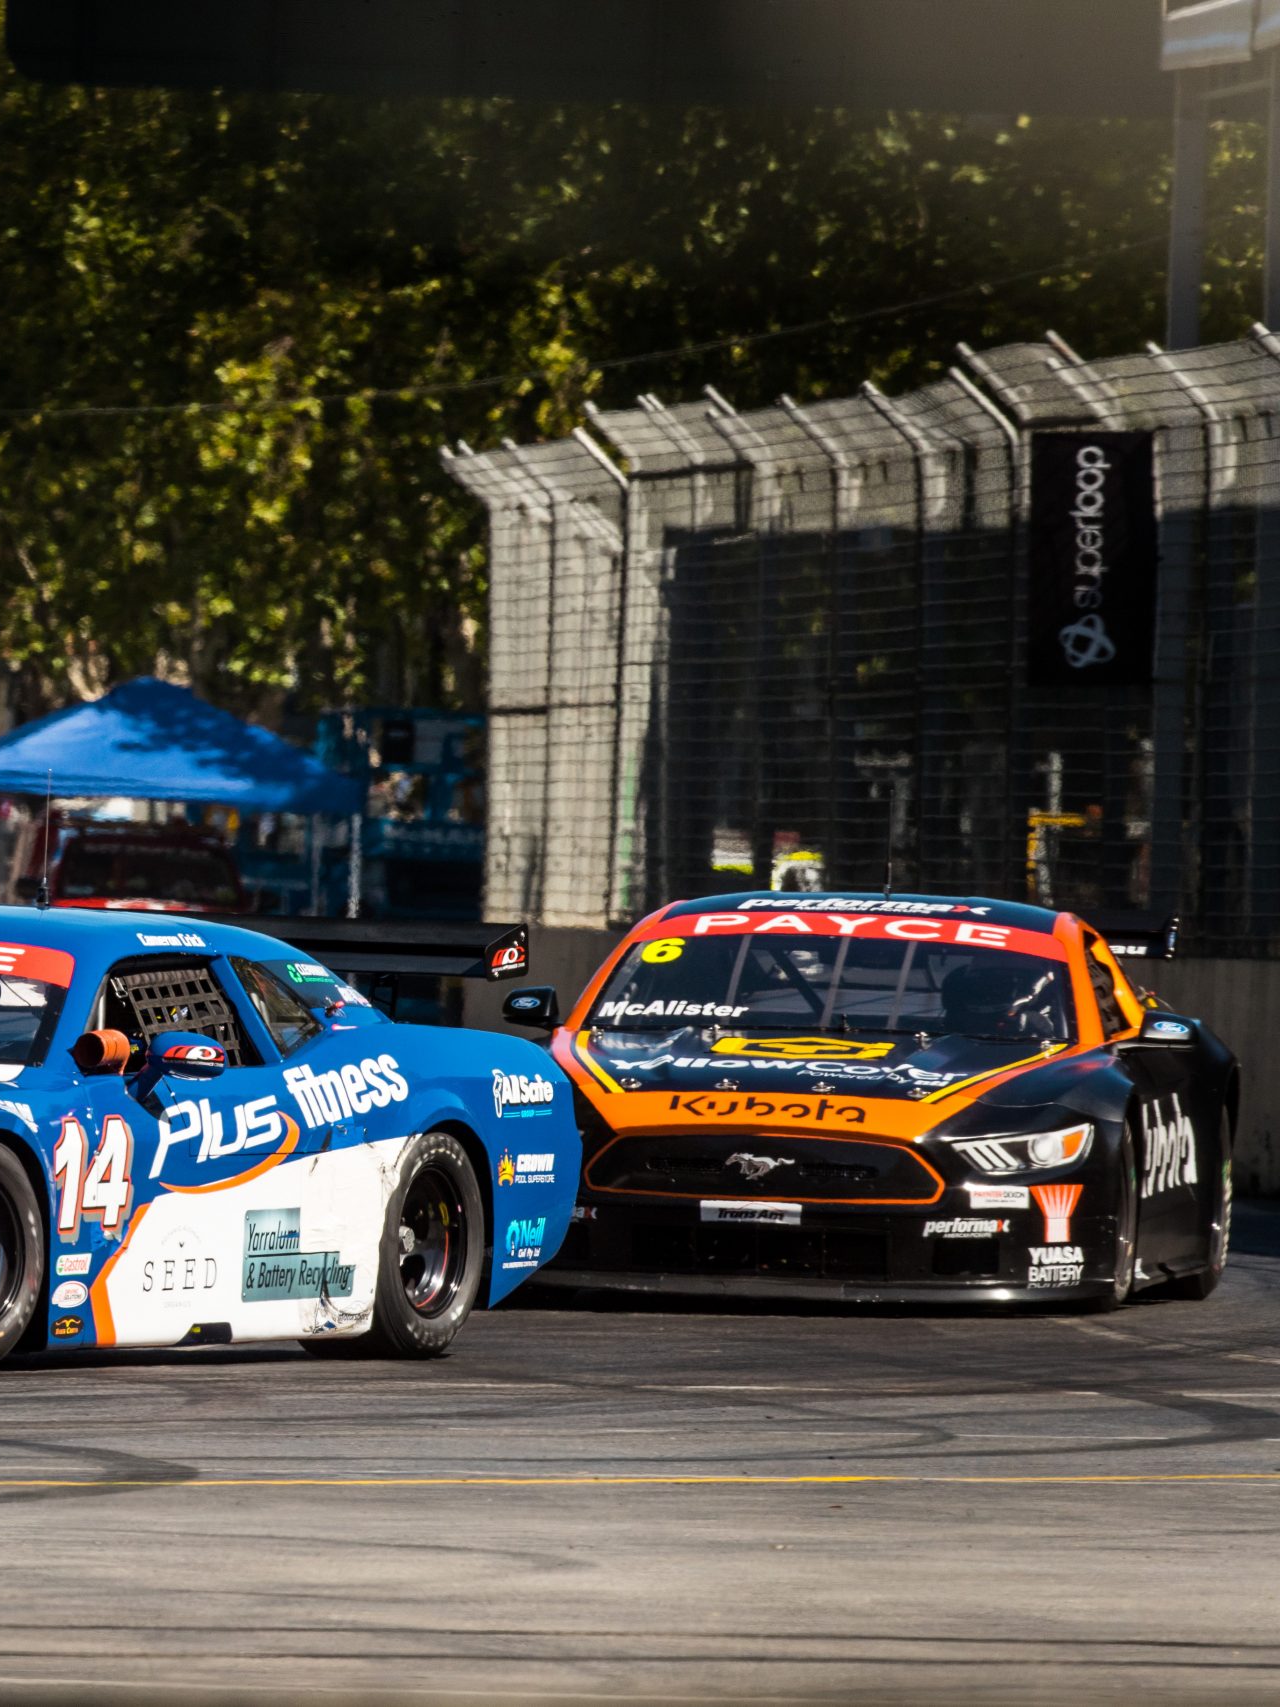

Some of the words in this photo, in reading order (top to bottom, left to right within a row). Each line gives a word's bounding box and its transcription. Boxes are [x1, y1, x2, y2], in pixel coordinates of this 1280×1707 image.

[1069, 446, 1111, 608] superloop
[737, 898, 991, 916] performax
[694, 914, 1011, 947] PAYCE
[641, 937, 686, 964] 6
[598, 1000, 749, 1018] McAlister
[148, 1094, 282, 1179] Plus
[283, 1054, 408, 1128] fitness
[669, 1094, 867, 1124] Kubota
[516, 1153, 554, 1172] CROWN
[53, 1114, 134, 1241] 14
[922, 1217, 1010, 1238] performax
[1028, 1246, 1084, 1265] YUASA
[142, 1258, 218, 1292] SEED
[246, 1262, 255, 1289] &
[257, 1260, 296, 1293] Battery
[1028, 1265, 1084, 1282] BATTERY
